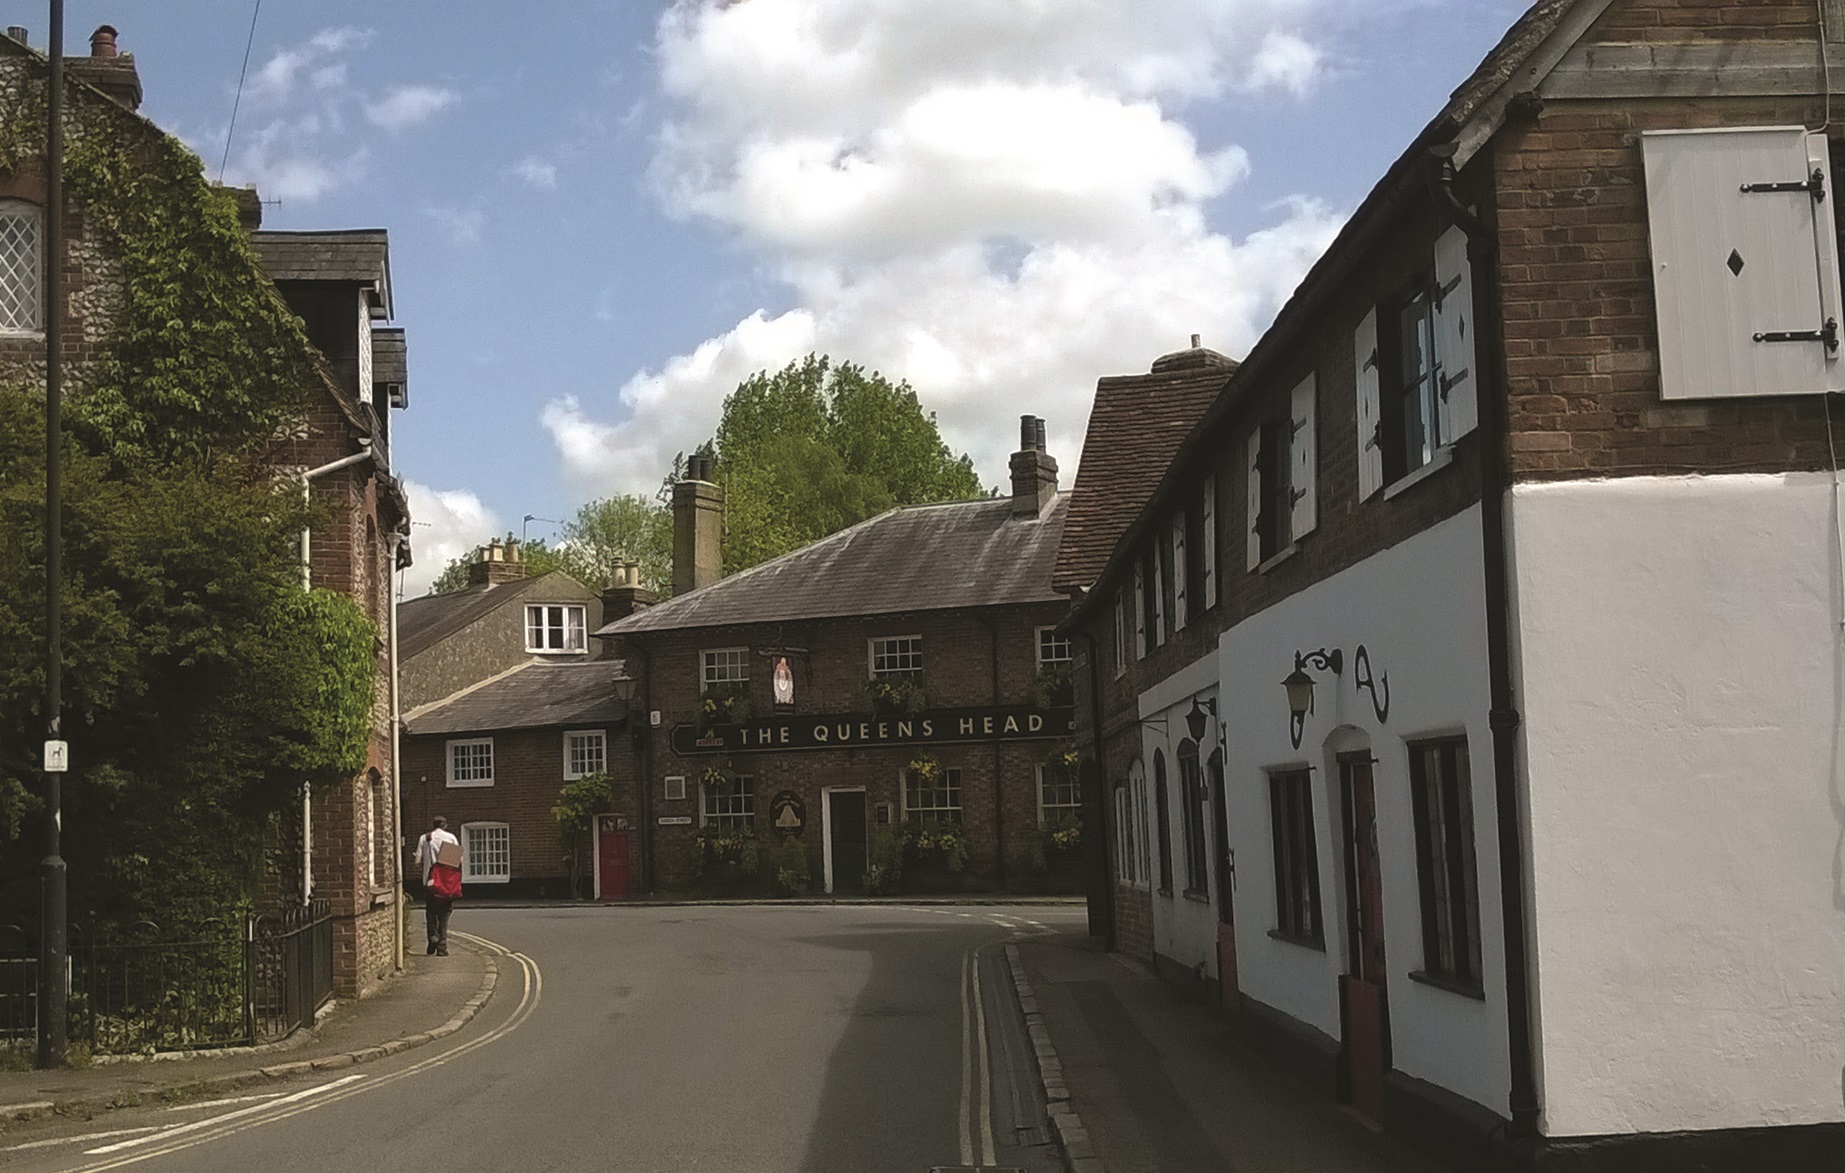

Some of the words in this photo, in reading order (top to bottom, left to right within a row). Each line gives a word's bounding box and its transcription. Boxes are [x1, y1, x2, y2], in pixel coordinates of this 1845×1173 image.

[740, 727, 789, 745] THE
[813, 720, 933, 742] QUEENS
[959, 714, 1043, 735] HEAD
